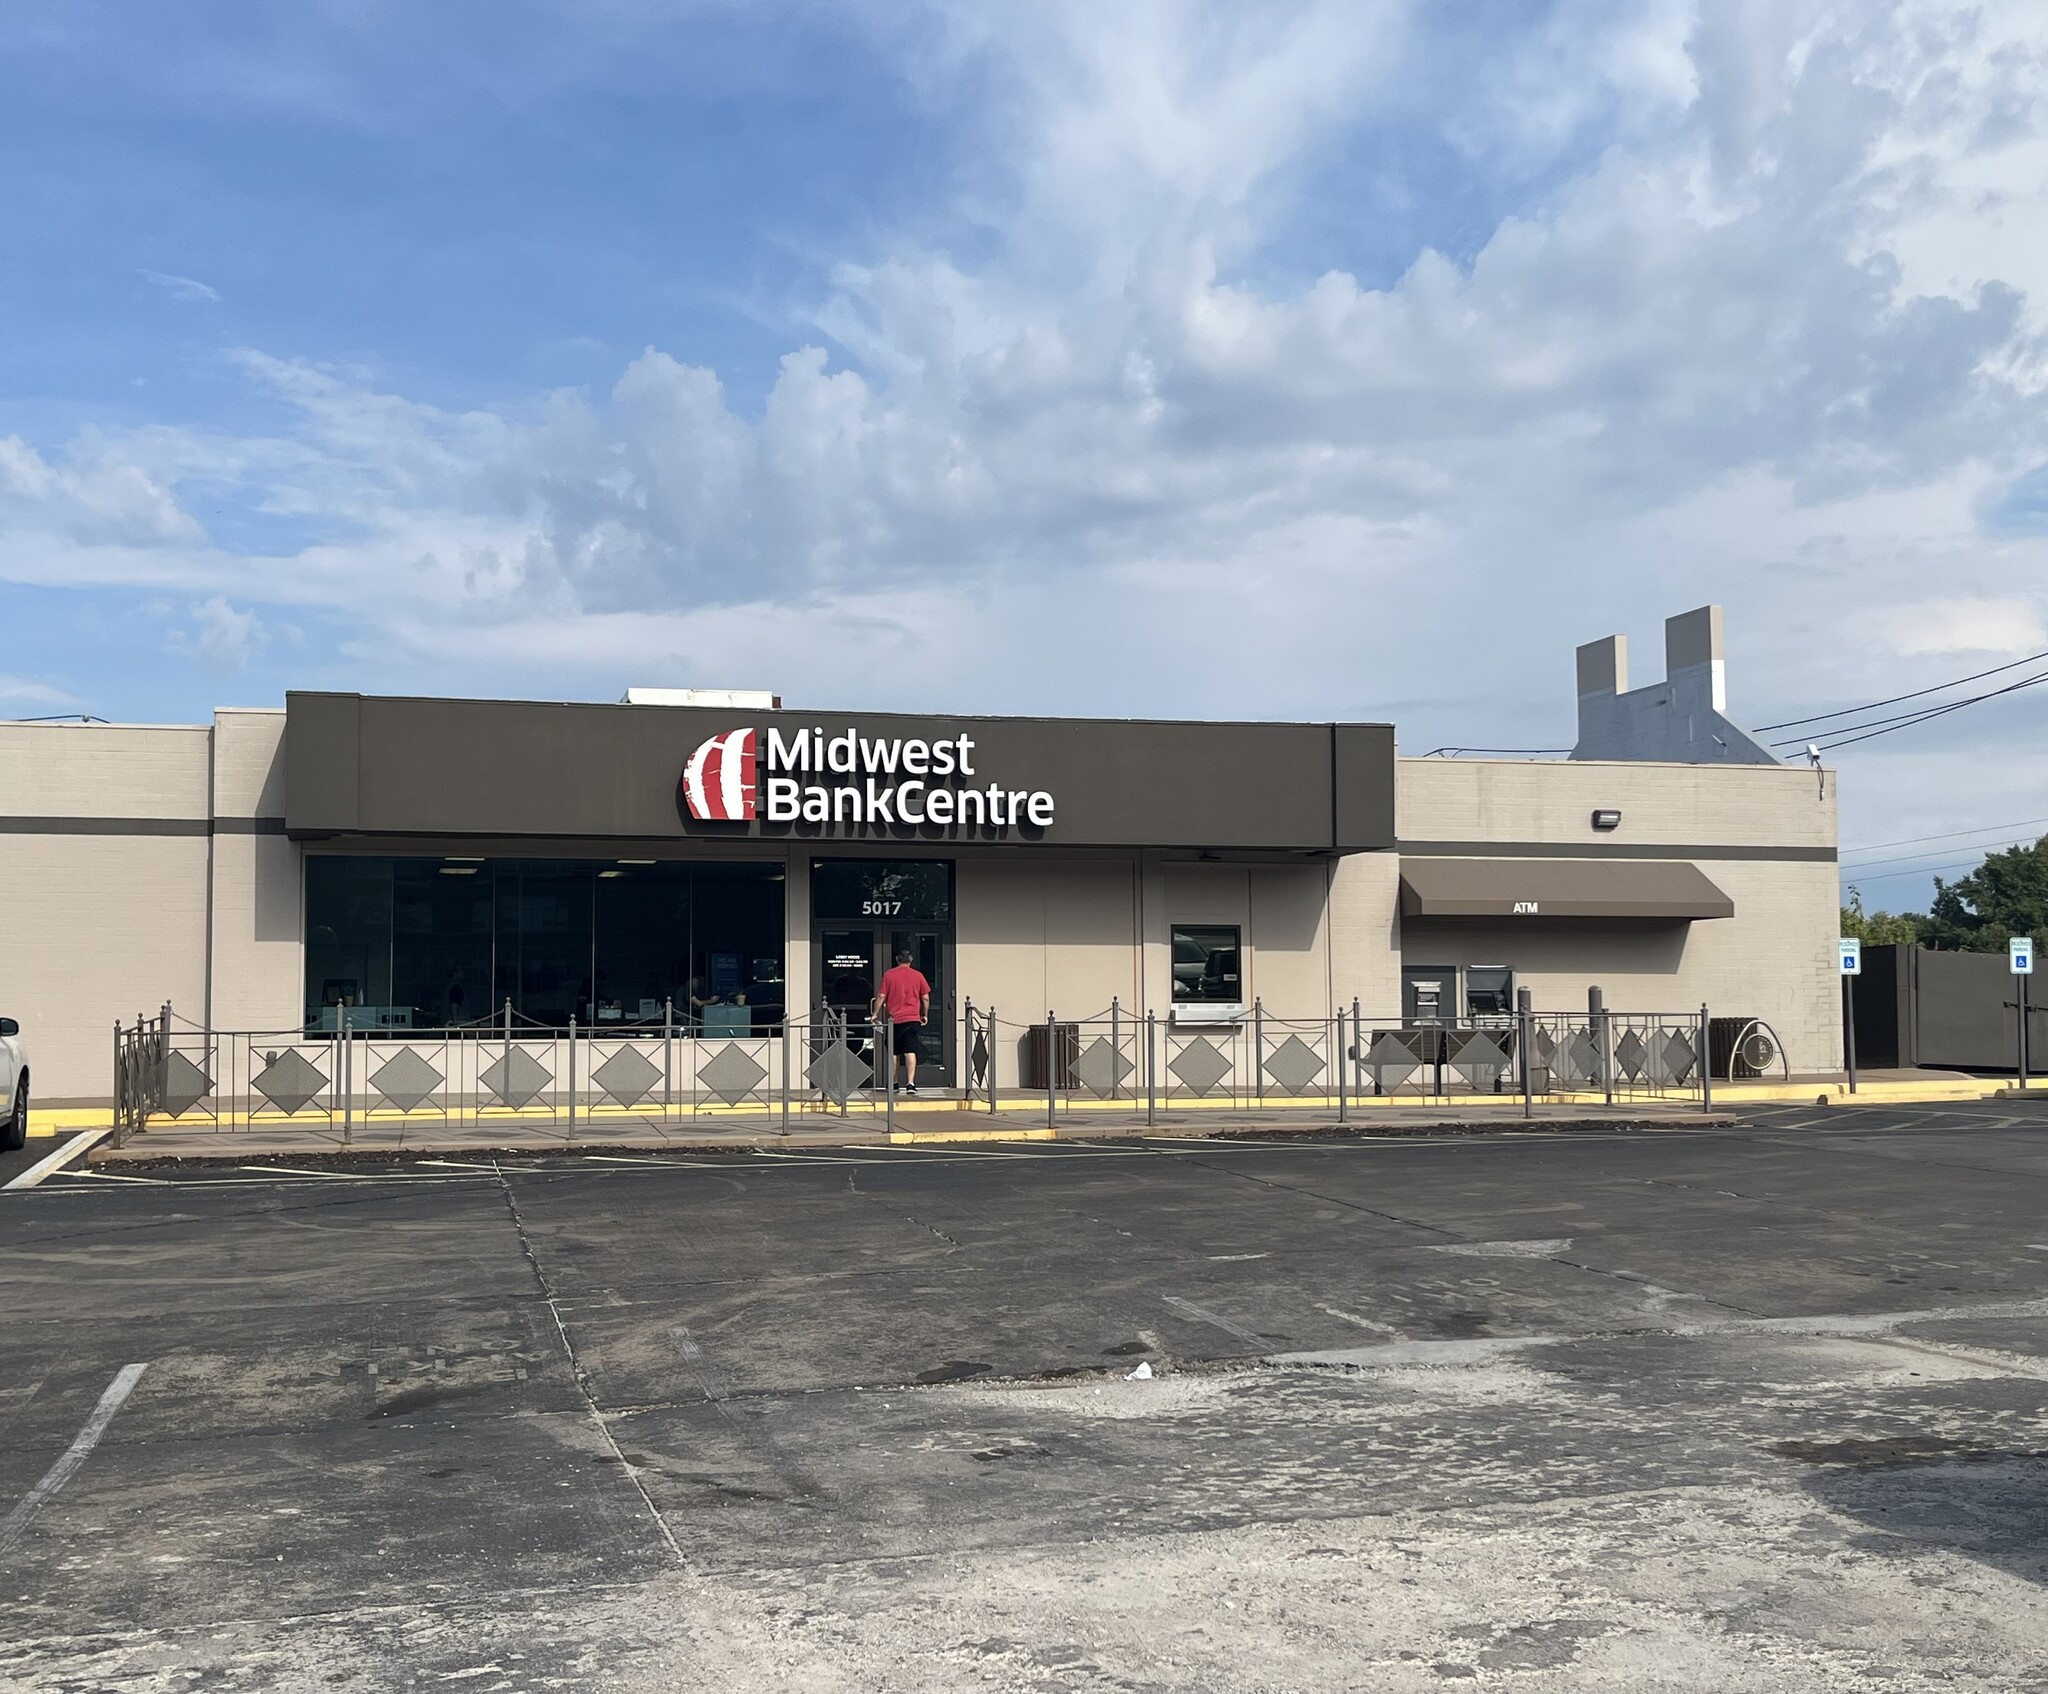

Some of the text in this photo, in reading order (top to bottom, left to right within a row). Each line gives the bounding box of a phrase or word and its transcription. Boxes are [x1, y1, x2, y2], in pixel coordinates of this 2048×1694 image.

[767, 727, 975, 775] Midwest
[767, 777, 1055, 827] BankCentre
[862, 901, 902, 915] 5017
[1512, 902, 1538, 914] ATM
